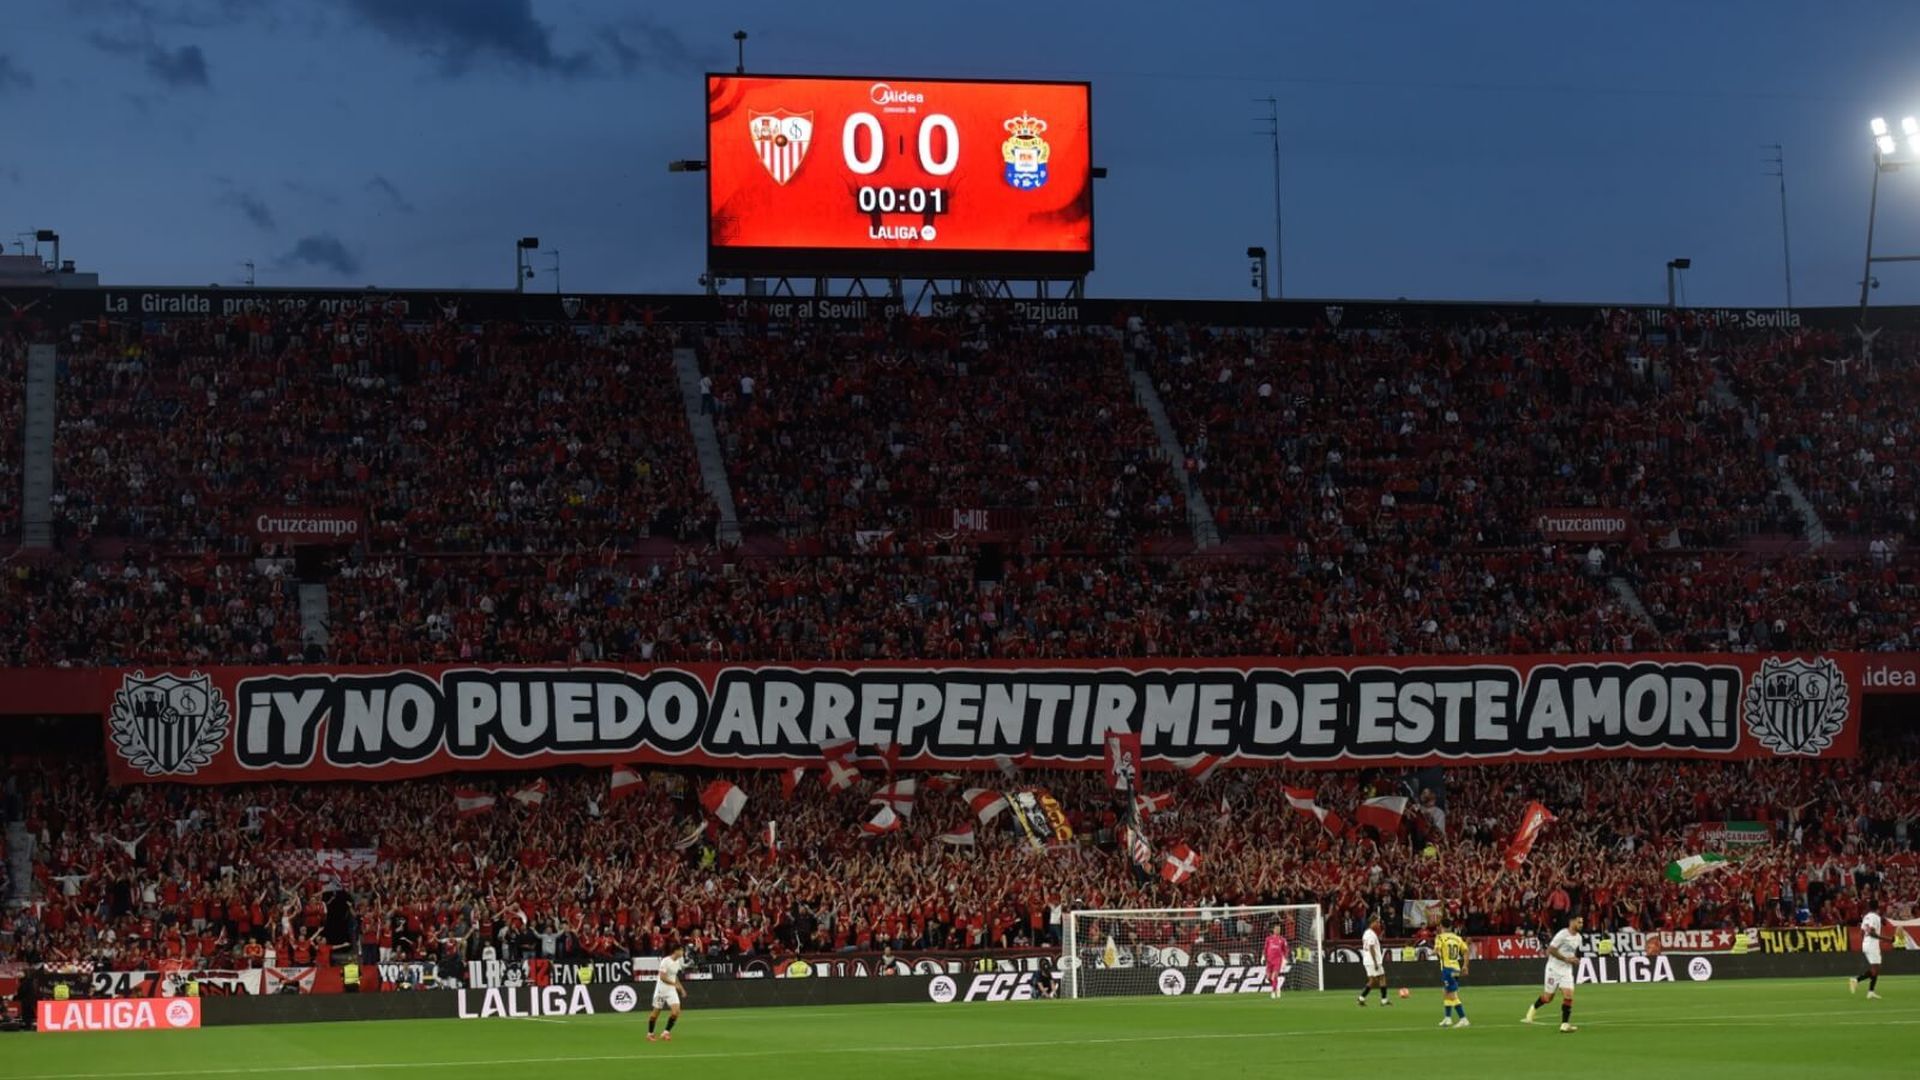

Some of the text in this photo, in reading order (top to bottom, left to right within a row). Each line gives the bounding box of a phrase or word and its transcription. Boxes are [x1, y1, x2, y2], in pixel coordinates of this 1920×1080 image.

[875, 87, 924, 104] Midea
[842, 111, 960, 176] 0 0
[859, 186, 943, 212] 00:01
[869, 226, 918, 240] LALIGA
[105, 293, 128, 313] La
[141, 292, 211, 313] Giralda
[799, 300, 813, 318] al
[818, 300, 868, 319] Sevill
[1746, 310, 1800, 328] Sevilla
[257, 514, 358, 537] Cruzcampo
[1862, 666, 1916, 686] idea
[337, 683, 435, 752] NO
[457, 680, 699, 746] PUEDO
[713, 680, 1233, 746] ARREPENTIRME
[1253, 682, 1340, 744] DE
[1357, 679, 1509, 744] ESTE
[1527, 673, 1728, 739] AMOR!
[1576, 955, 1676, 984] ALIGA
[458, 984, 595, 1019] LALIGA
[45, 1001, 156, 1030] LALIGA
